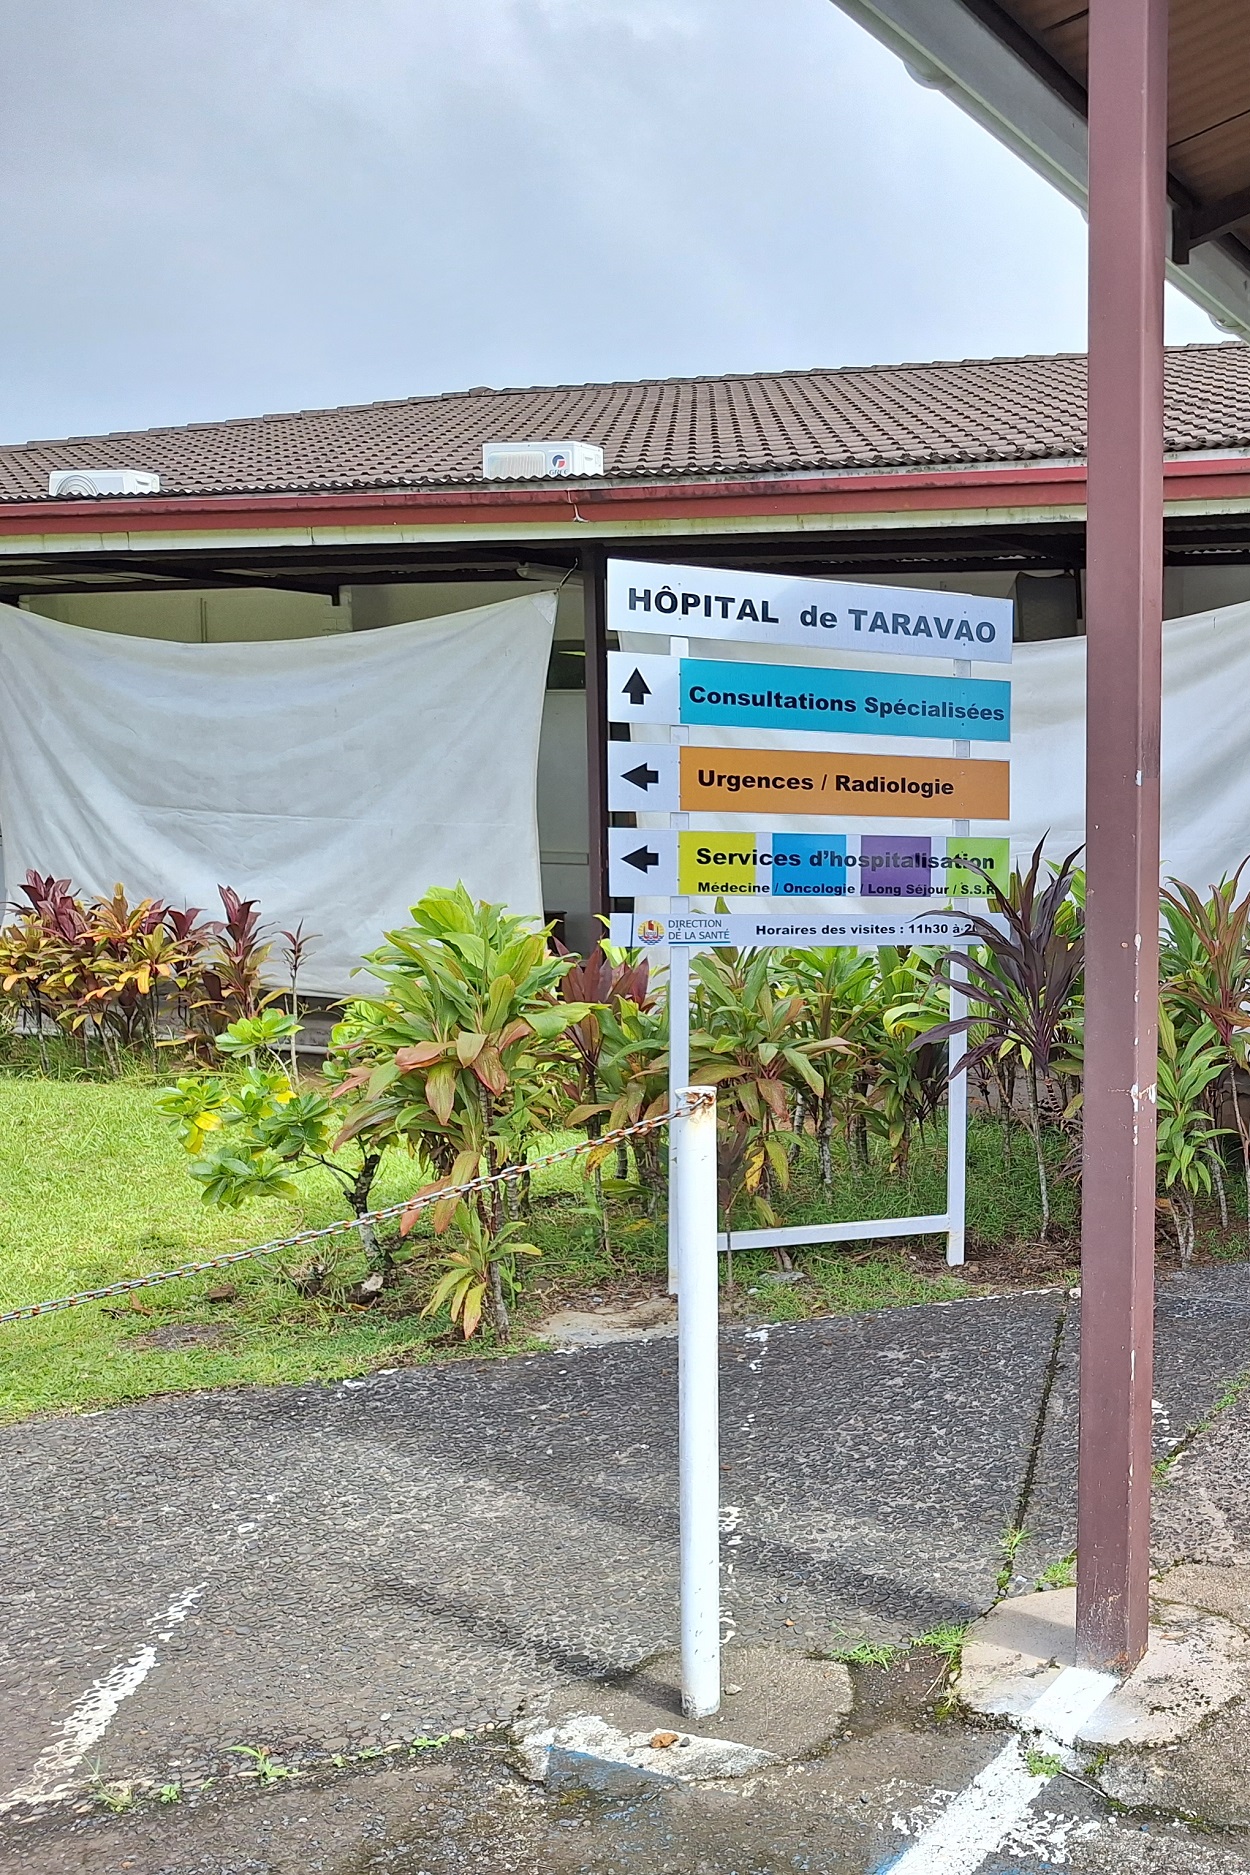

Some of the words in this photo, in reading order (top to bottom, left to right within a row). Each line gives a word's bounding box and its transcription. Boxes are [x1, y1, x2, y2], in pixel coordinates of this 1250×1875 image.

[628, 585, 780, 624] HÔPITAL
[800, 605, 838, 629] de
[848, 608, 996, 644] TARAVAO
[688, 686, 857, 714] Consultations
[864, 696, 1005, 721] Spécialisées
[697, 769, 814, 793] Urgences
[821, 774, 828, 792] /
[835, 774, 955, 799] Radiologie
[696, 847, 801, 867] Services
[809, 850, 995, 872] d'hospitalisation
[697, 881, 770, 893] Médecine
[774, 882, 779, 893] /
[783, 882, 856, 896] Oncologie
[859, 884, 864, 895] /
[868, 884, 902, 896] Long
[906, 883, 949, 896] Séjour
[953, 884, 957, 895] /
[668, 919, 722, 929] DIRECTION
[668, 931, 681, 940] DE
[684, 931, 697, 940] LA
[699, 928, 730, 940] SANTÉ
[756, 924, 817, 935] Horaires
[821, 924, 846, 935] des
[850, 924, 896, 934] visites
[909, 924, 948, 934] 11h30
[952, 923, 960, 934] à
